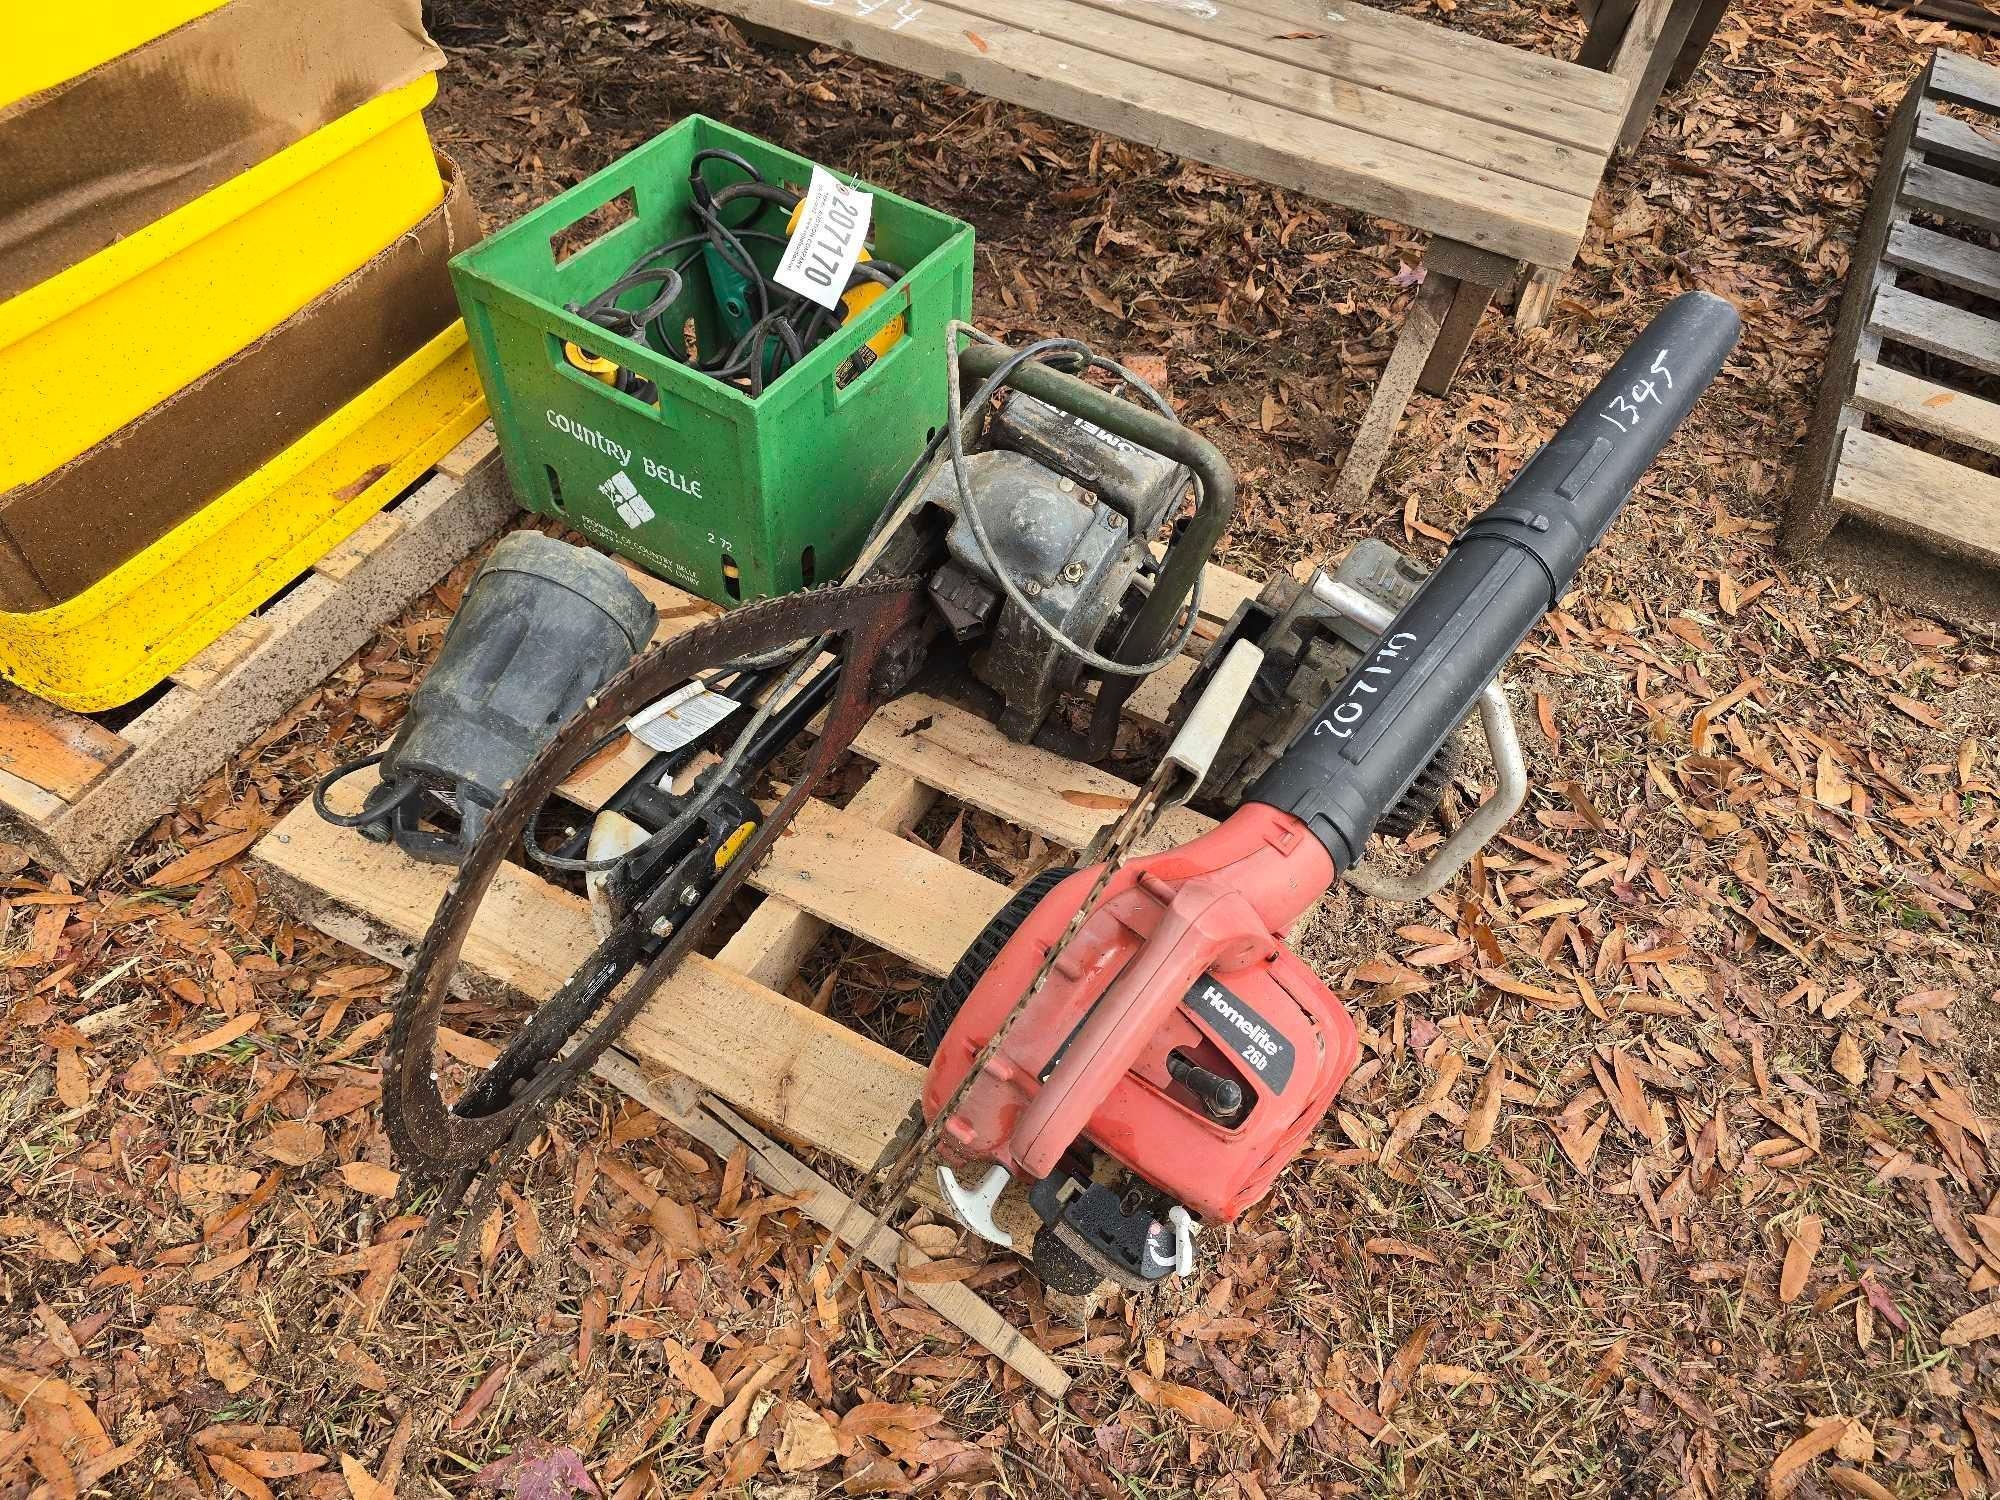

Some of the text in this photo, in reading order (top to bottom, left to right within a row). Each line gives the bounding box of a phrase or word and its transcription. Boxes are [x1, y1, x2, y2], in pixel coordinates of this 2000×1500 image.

[796, 238, 813, 270] COMPANY
[804, 196, 858, 287] 207170
[1600, 349, 1673, 432] 1345
[642, 456, 703, 499] BELLE
[581, 514, 619, 539] PROPERTY
[633, 542, 673, 567] COUNTRY
[675, 563, 697, 579] BELLE
[707, 532, 733, 552] 2 72
[1201, 985, 1279, 1056] Homelite
